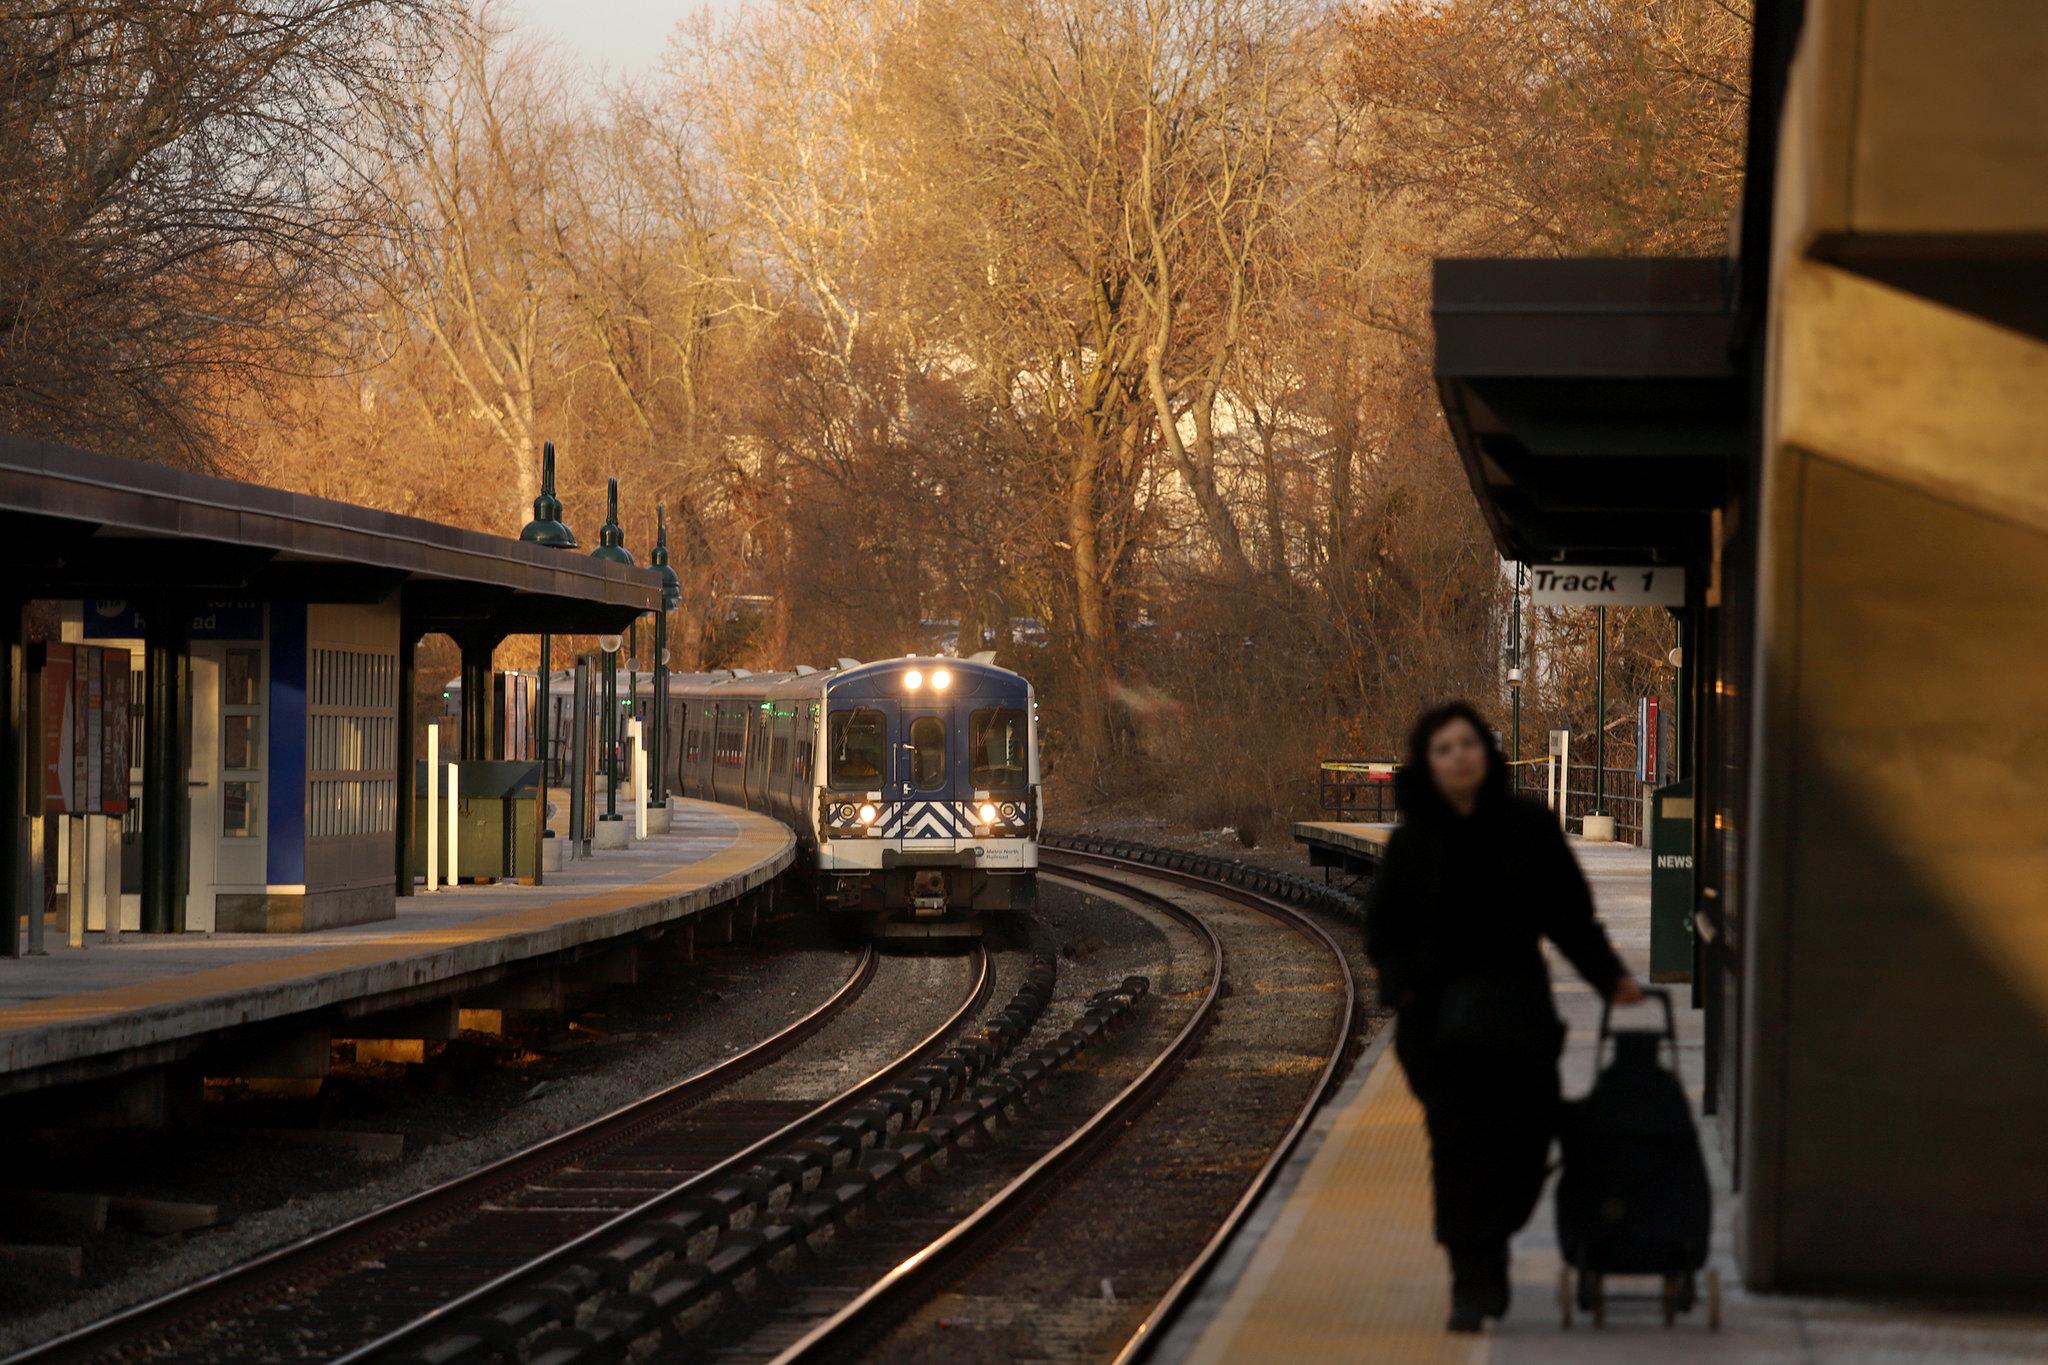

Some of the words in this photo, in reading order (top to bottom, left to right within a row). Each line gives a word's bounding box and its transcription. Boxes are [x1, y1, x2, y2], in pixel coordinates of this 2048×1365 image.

[1535, 570, 1618, 592] Track
[1641, 571, 1654, 592] 1
[1657, 855, 1693, 869] NEWS
